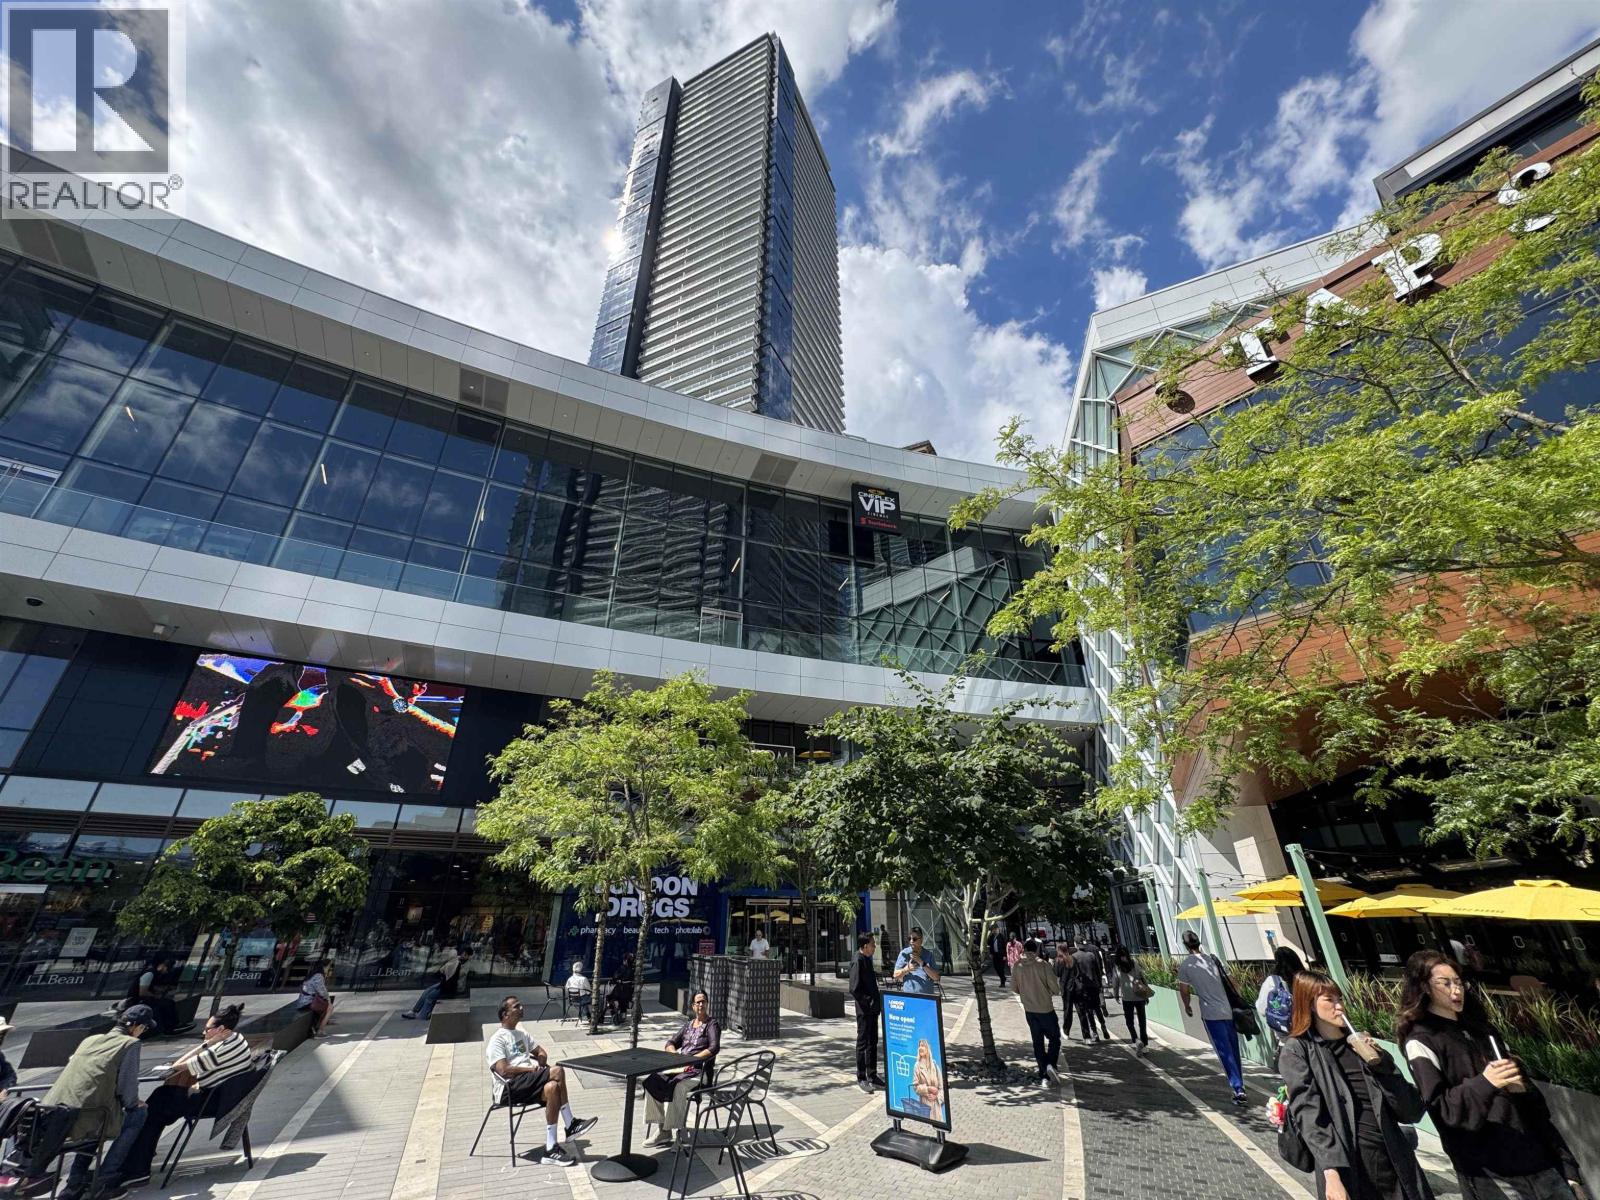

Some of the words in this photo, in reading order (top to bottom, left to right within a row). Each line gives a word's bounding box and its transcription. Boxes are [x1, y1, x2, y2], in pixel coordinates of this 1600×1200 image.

[858, 491, 895, 503] CINEPLEX
[859, 496, 896, 514] VIP
[580, 926, 616, 936] pharacy
[623, 926, 642, 934] beau
[654, 926, 670, 934] tech
[675, 926, 703, 936] photolab
